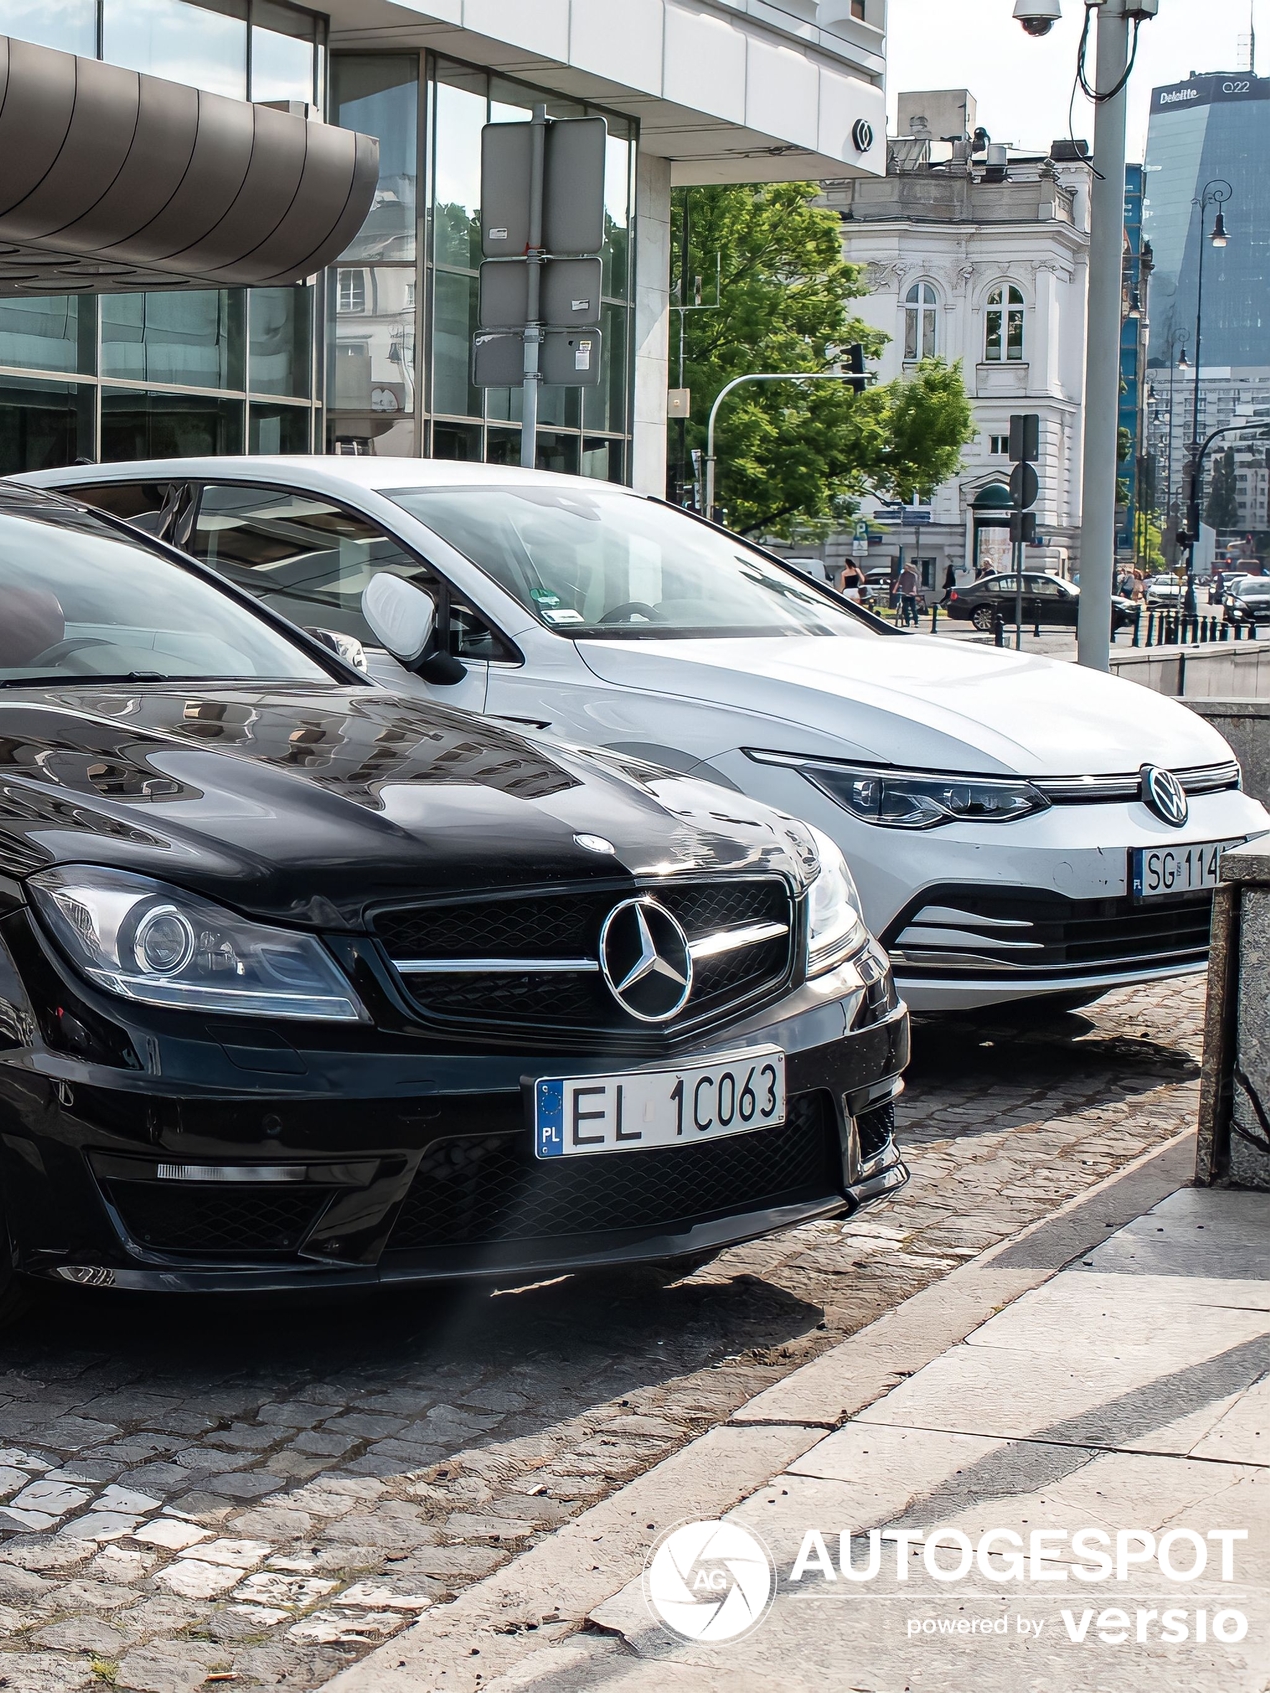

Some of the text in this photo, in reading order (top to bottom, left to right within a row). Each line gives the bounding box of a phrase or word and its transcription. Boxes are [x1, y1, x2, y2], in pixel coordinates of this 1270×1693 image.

[1222, 81, 1250, 93] Q22
[1160, 88, 1199, 105] Deloitte
[1148, 845, 1226, 891] SG 114
[572, 1063, 778, 1147] EL 1C063
[542, 1127, 560, 1143] PL
